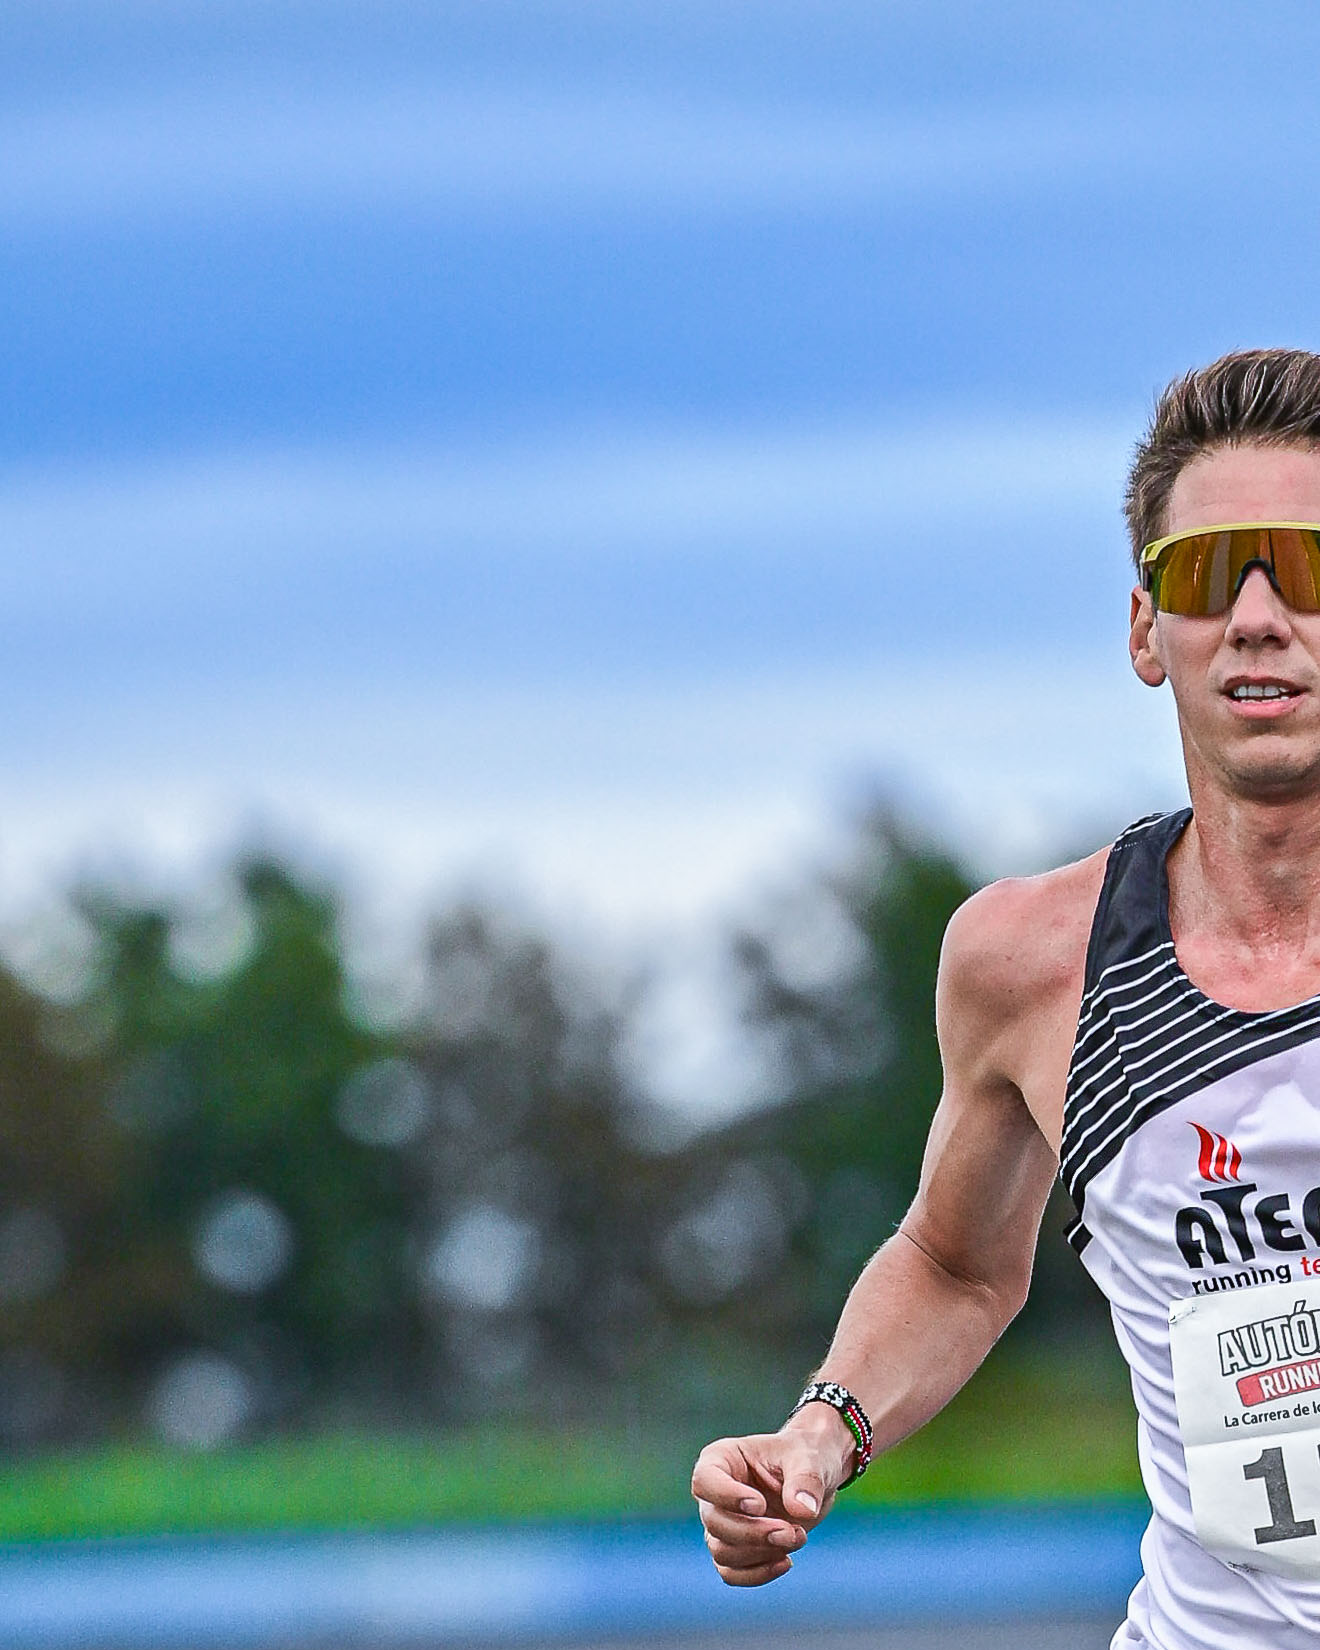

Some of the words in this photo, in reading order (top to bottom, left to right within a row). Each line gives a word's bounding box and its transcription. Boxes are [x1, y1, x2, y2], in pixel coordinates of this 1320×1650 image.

[1192, 1264, 1292, 1295] running
[1224, 1415, 1240, 1428] La
[1242, 1409, 1290, 1426] Carrera
[1293, 1403, 1310, 1417] de
